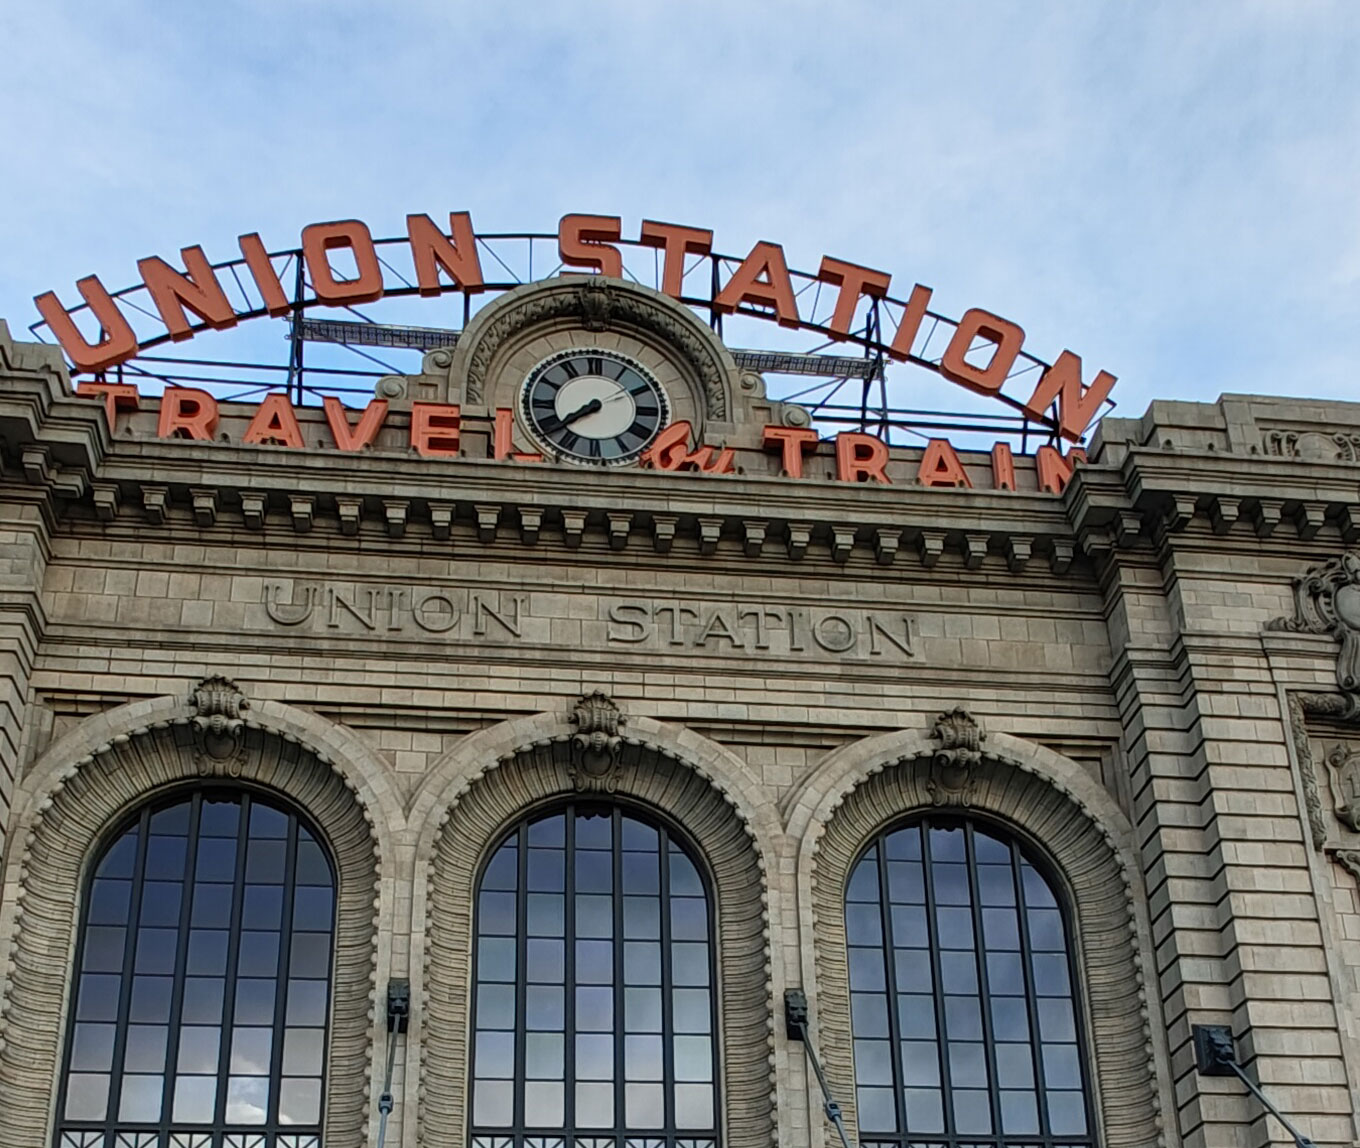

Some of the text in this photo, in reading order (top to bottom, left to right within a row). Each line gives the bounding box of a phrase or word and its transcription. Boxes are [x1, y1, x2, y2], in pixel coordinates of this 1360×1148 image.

[33, 211, 1119, 443] UNION STATION
[77, 382, 542, 462] TRAVEL
[762, 425, 1089, 494] TRAIN
[264, 584, 915, 657] UNION STATION
